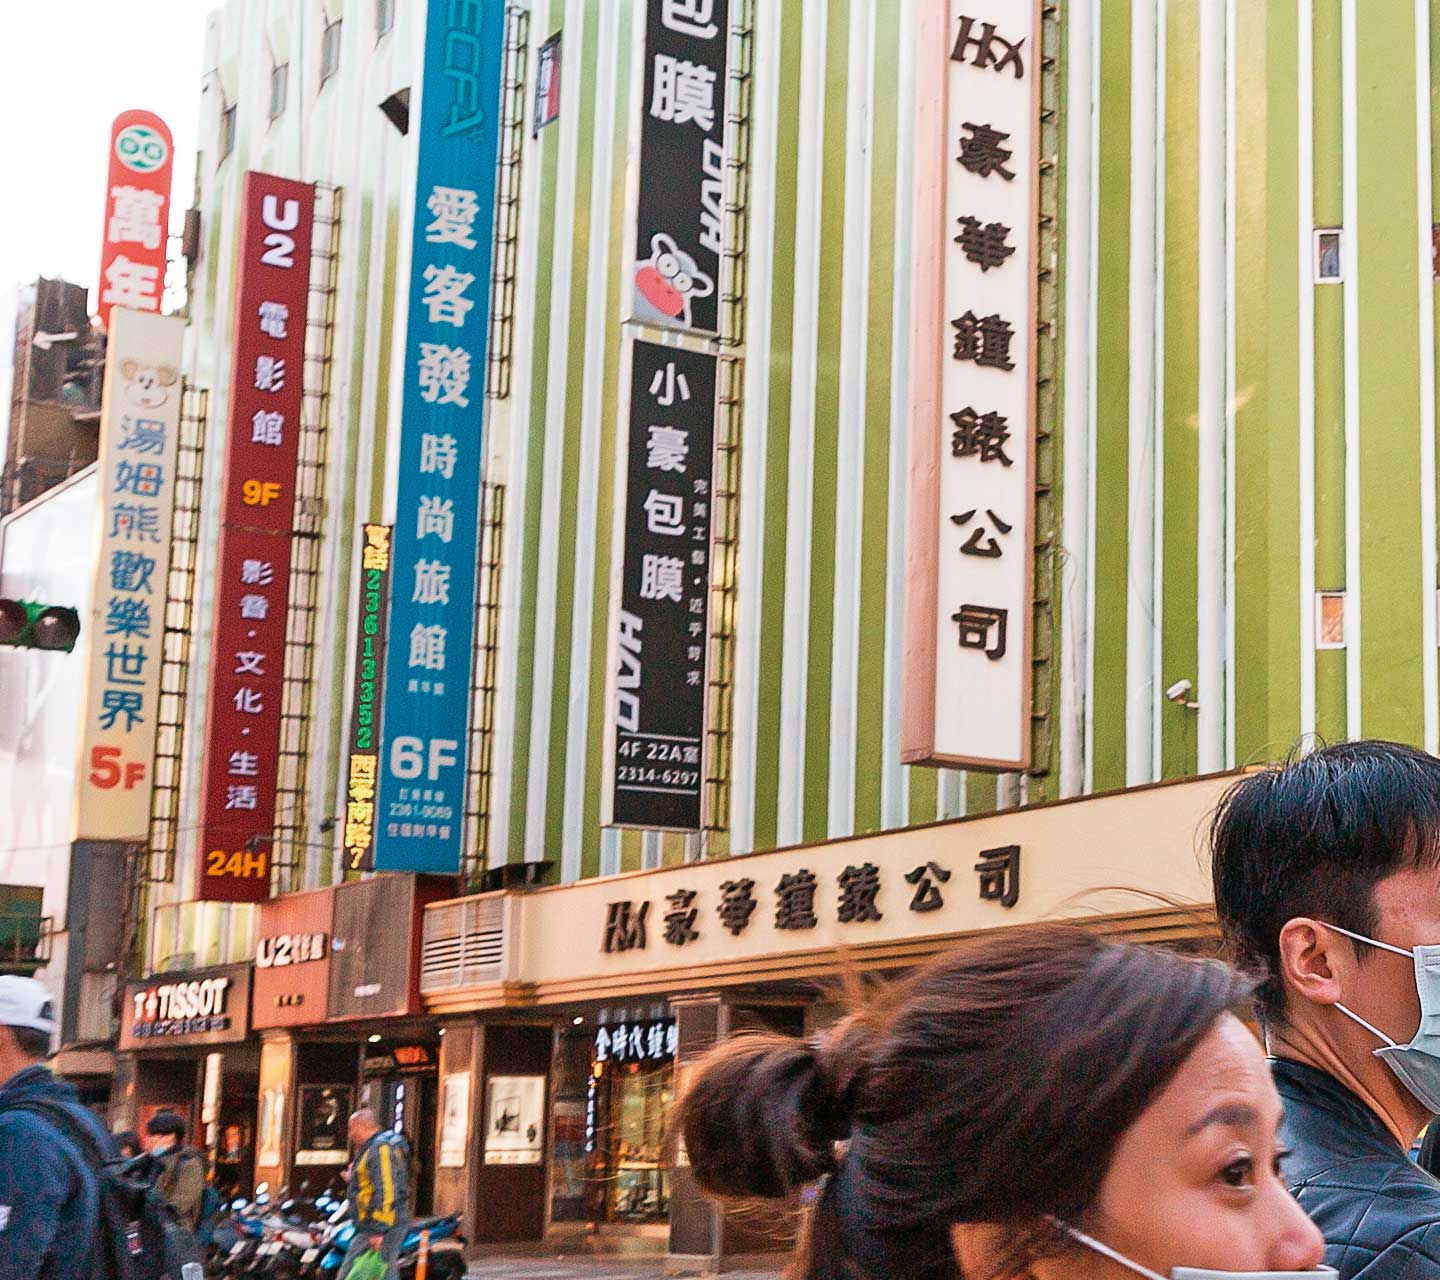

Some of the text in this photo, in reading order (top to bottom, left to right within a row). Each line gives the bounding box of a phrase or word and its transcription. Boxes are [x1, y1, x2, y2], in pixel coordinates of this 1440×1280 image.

[103, 184, 165, 311] 萬年
[241, 194, 301, 507] U2 電影館 9F
[948, 119, 1018, 664] 豪華鐘錶公司
[406, 185, 481, 671] 愛客發 時尚旅館
[639, 361, 691, 603] 小豪包膜
[97, 414, 167, 735] 湯姆熊歡樂世界
[88, 744, 146, 792] 5F
[390, 735, 459, 782] 6F
[617, 764, 700, 786] 2314-6297
[618, 741, 643, 761] 4F
[206, 849, 267, 881] 24H
[256, 933, 293, 969] U2
[158, 976, 229, 1019] TISSOT
